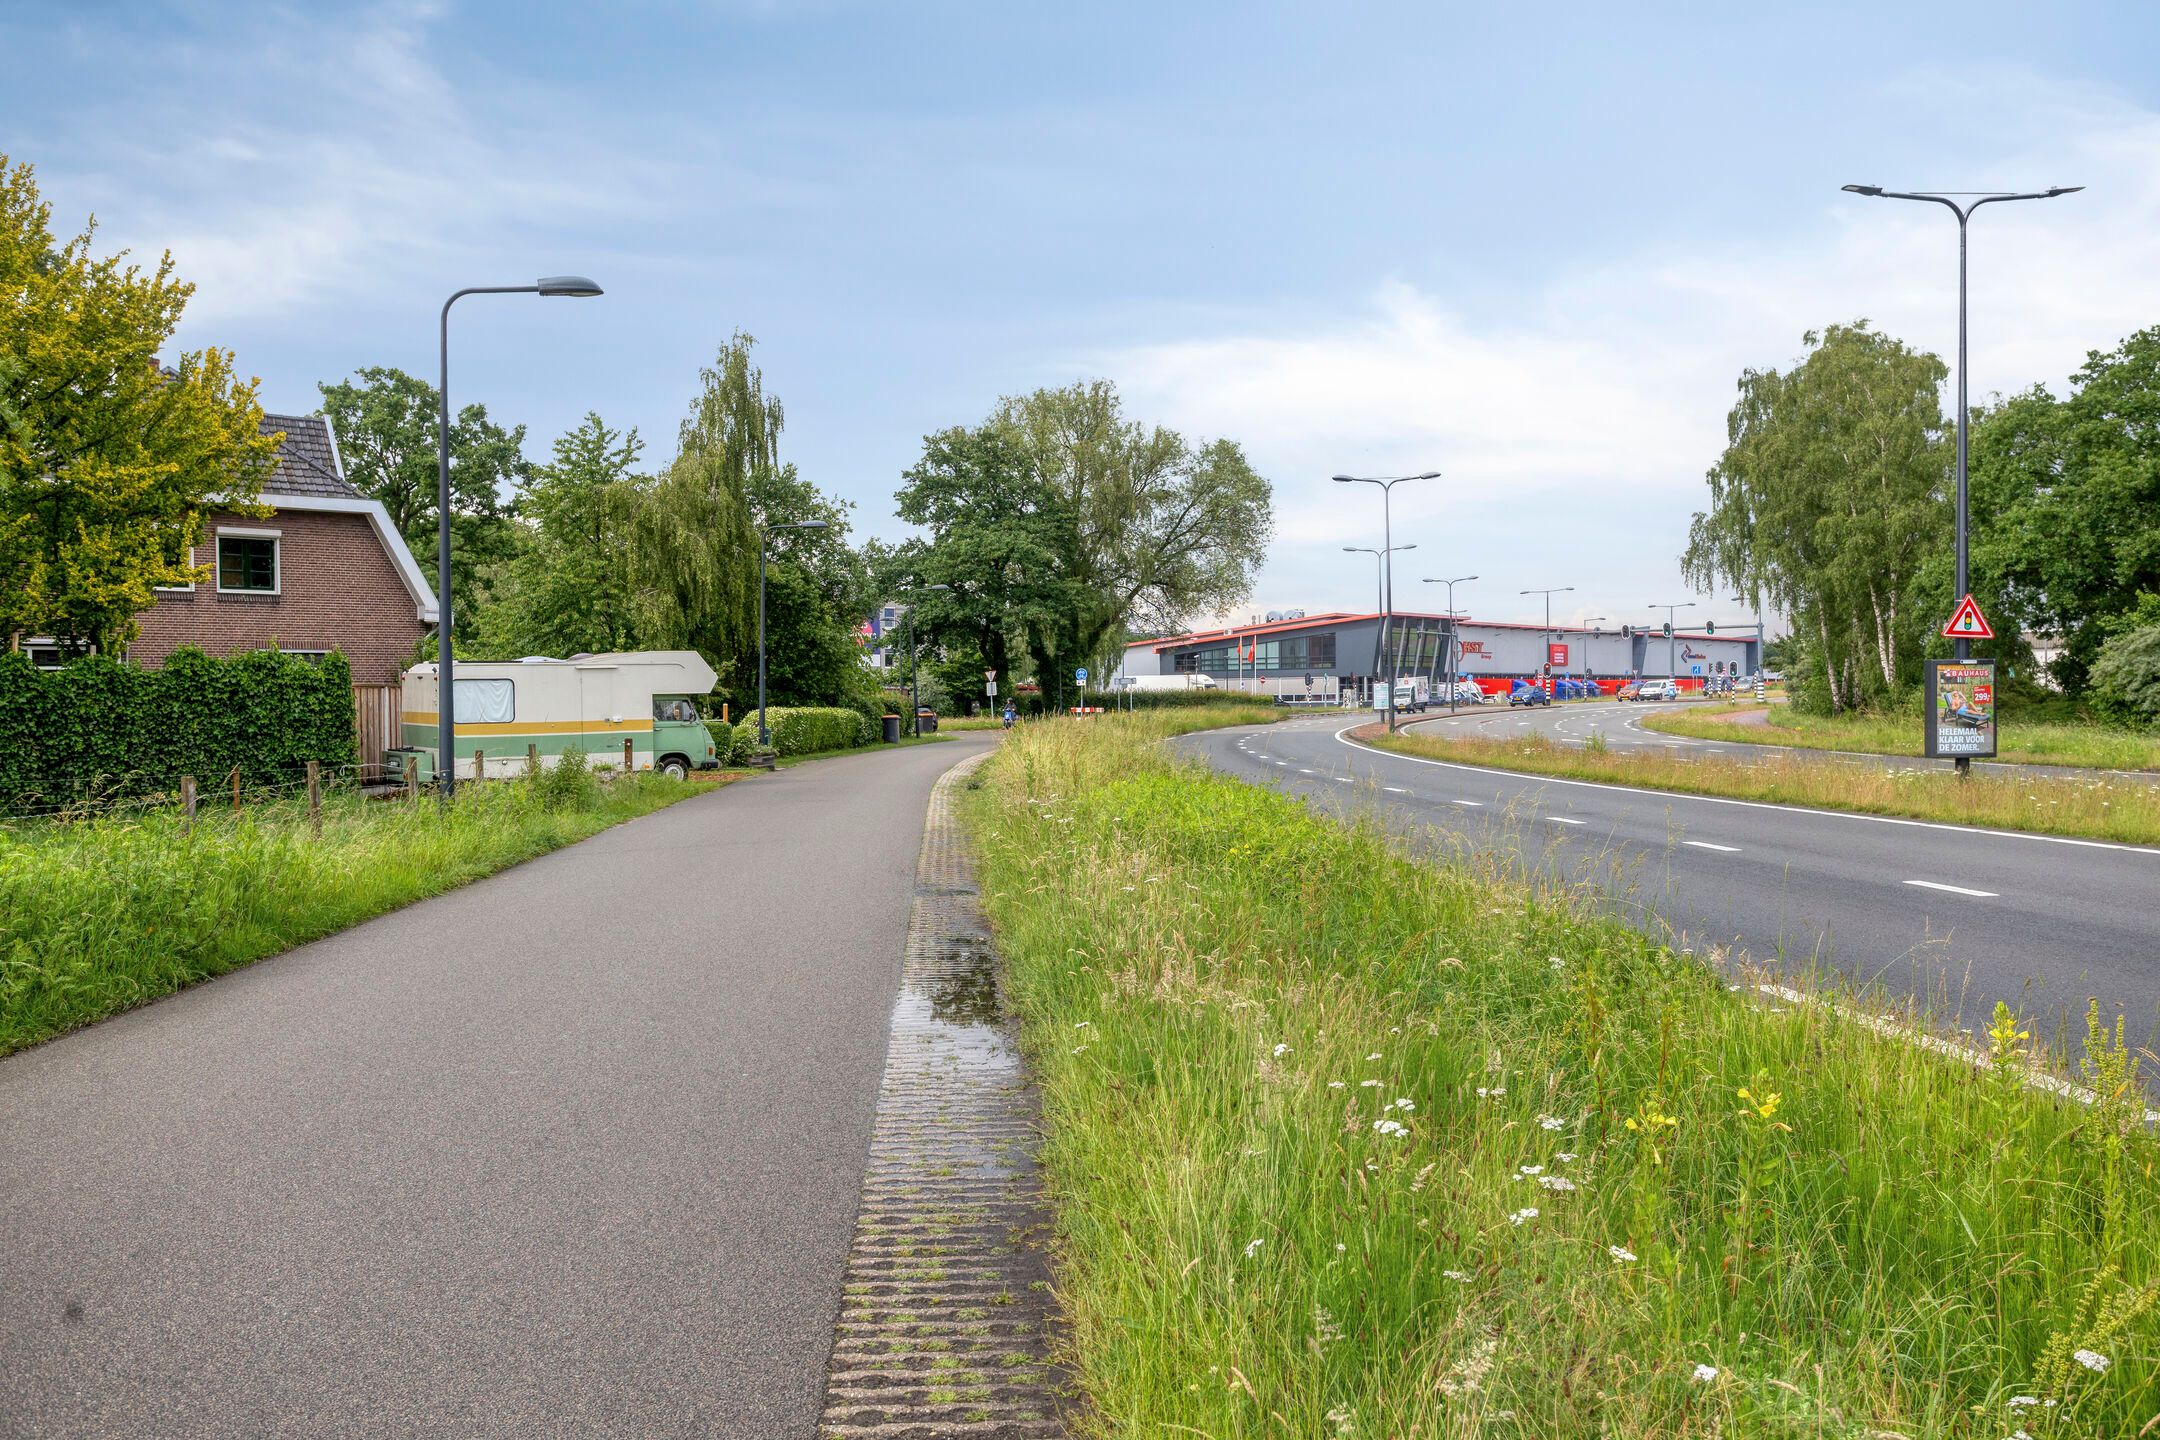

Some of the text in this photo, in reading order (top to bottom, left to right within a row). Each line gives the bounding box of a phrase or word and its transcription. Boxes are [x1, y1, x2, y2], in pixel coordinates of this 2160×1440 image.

[1463, 641, 1484, 652] HST
[1939, 727, 1978, 735] HELEMAAL
[1939, 735, 1985, 743] KLAAR VOOR
[1939, 743, 1980, 751] DE ZOMER.
